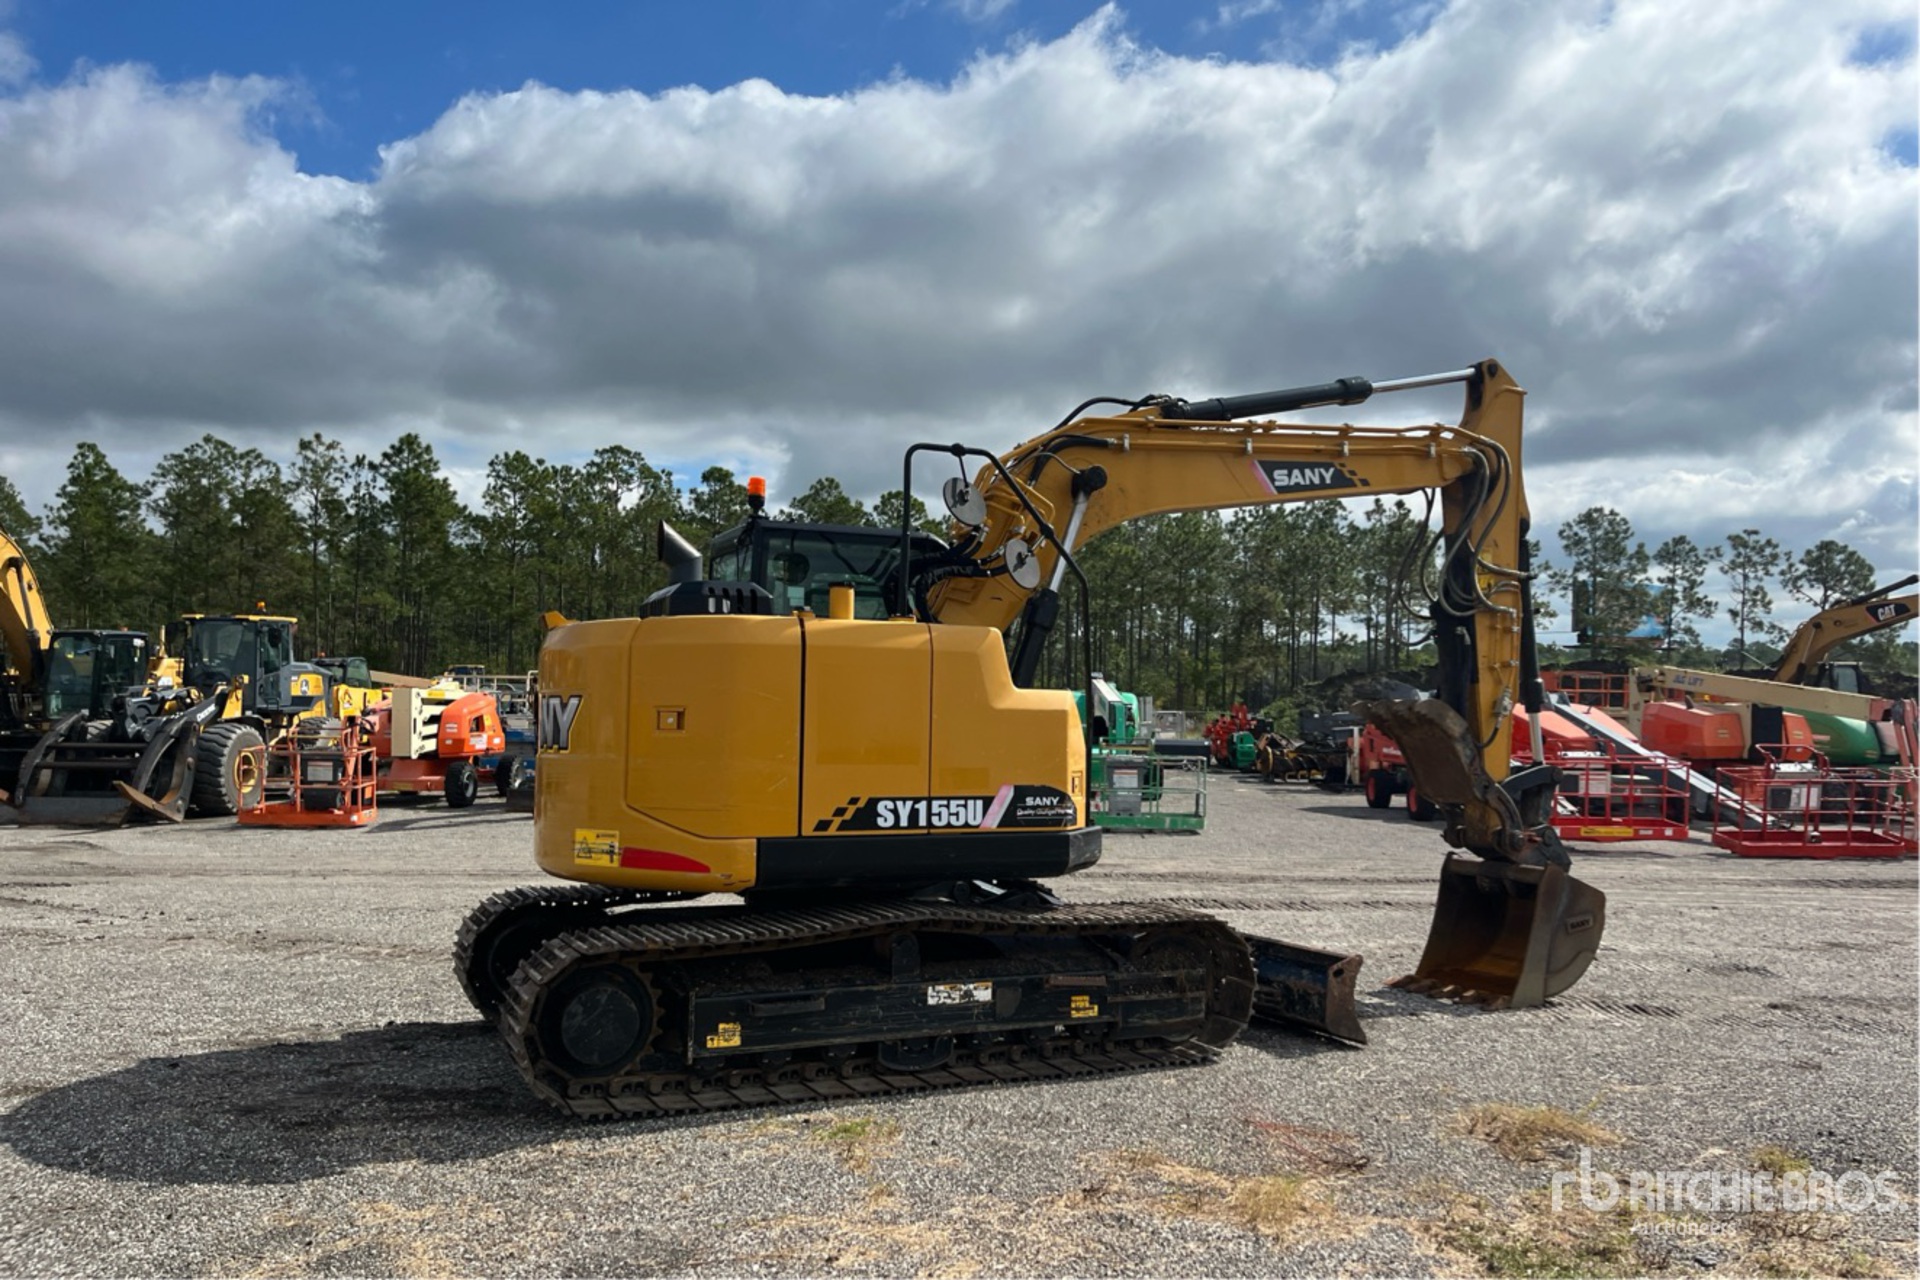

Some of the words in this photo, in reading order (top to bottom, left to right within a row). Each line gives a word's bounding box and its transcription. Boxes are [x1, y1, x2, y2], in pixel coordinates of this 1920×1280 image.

[1273, 467, 1335, 487] SANY
[1877, 604, 1896, 621] CAT
[1687, 676, 1704, 687] LIFT
[1025, 796, 1060, 807] SANY
[876, 799, 984, 828] SY155U
